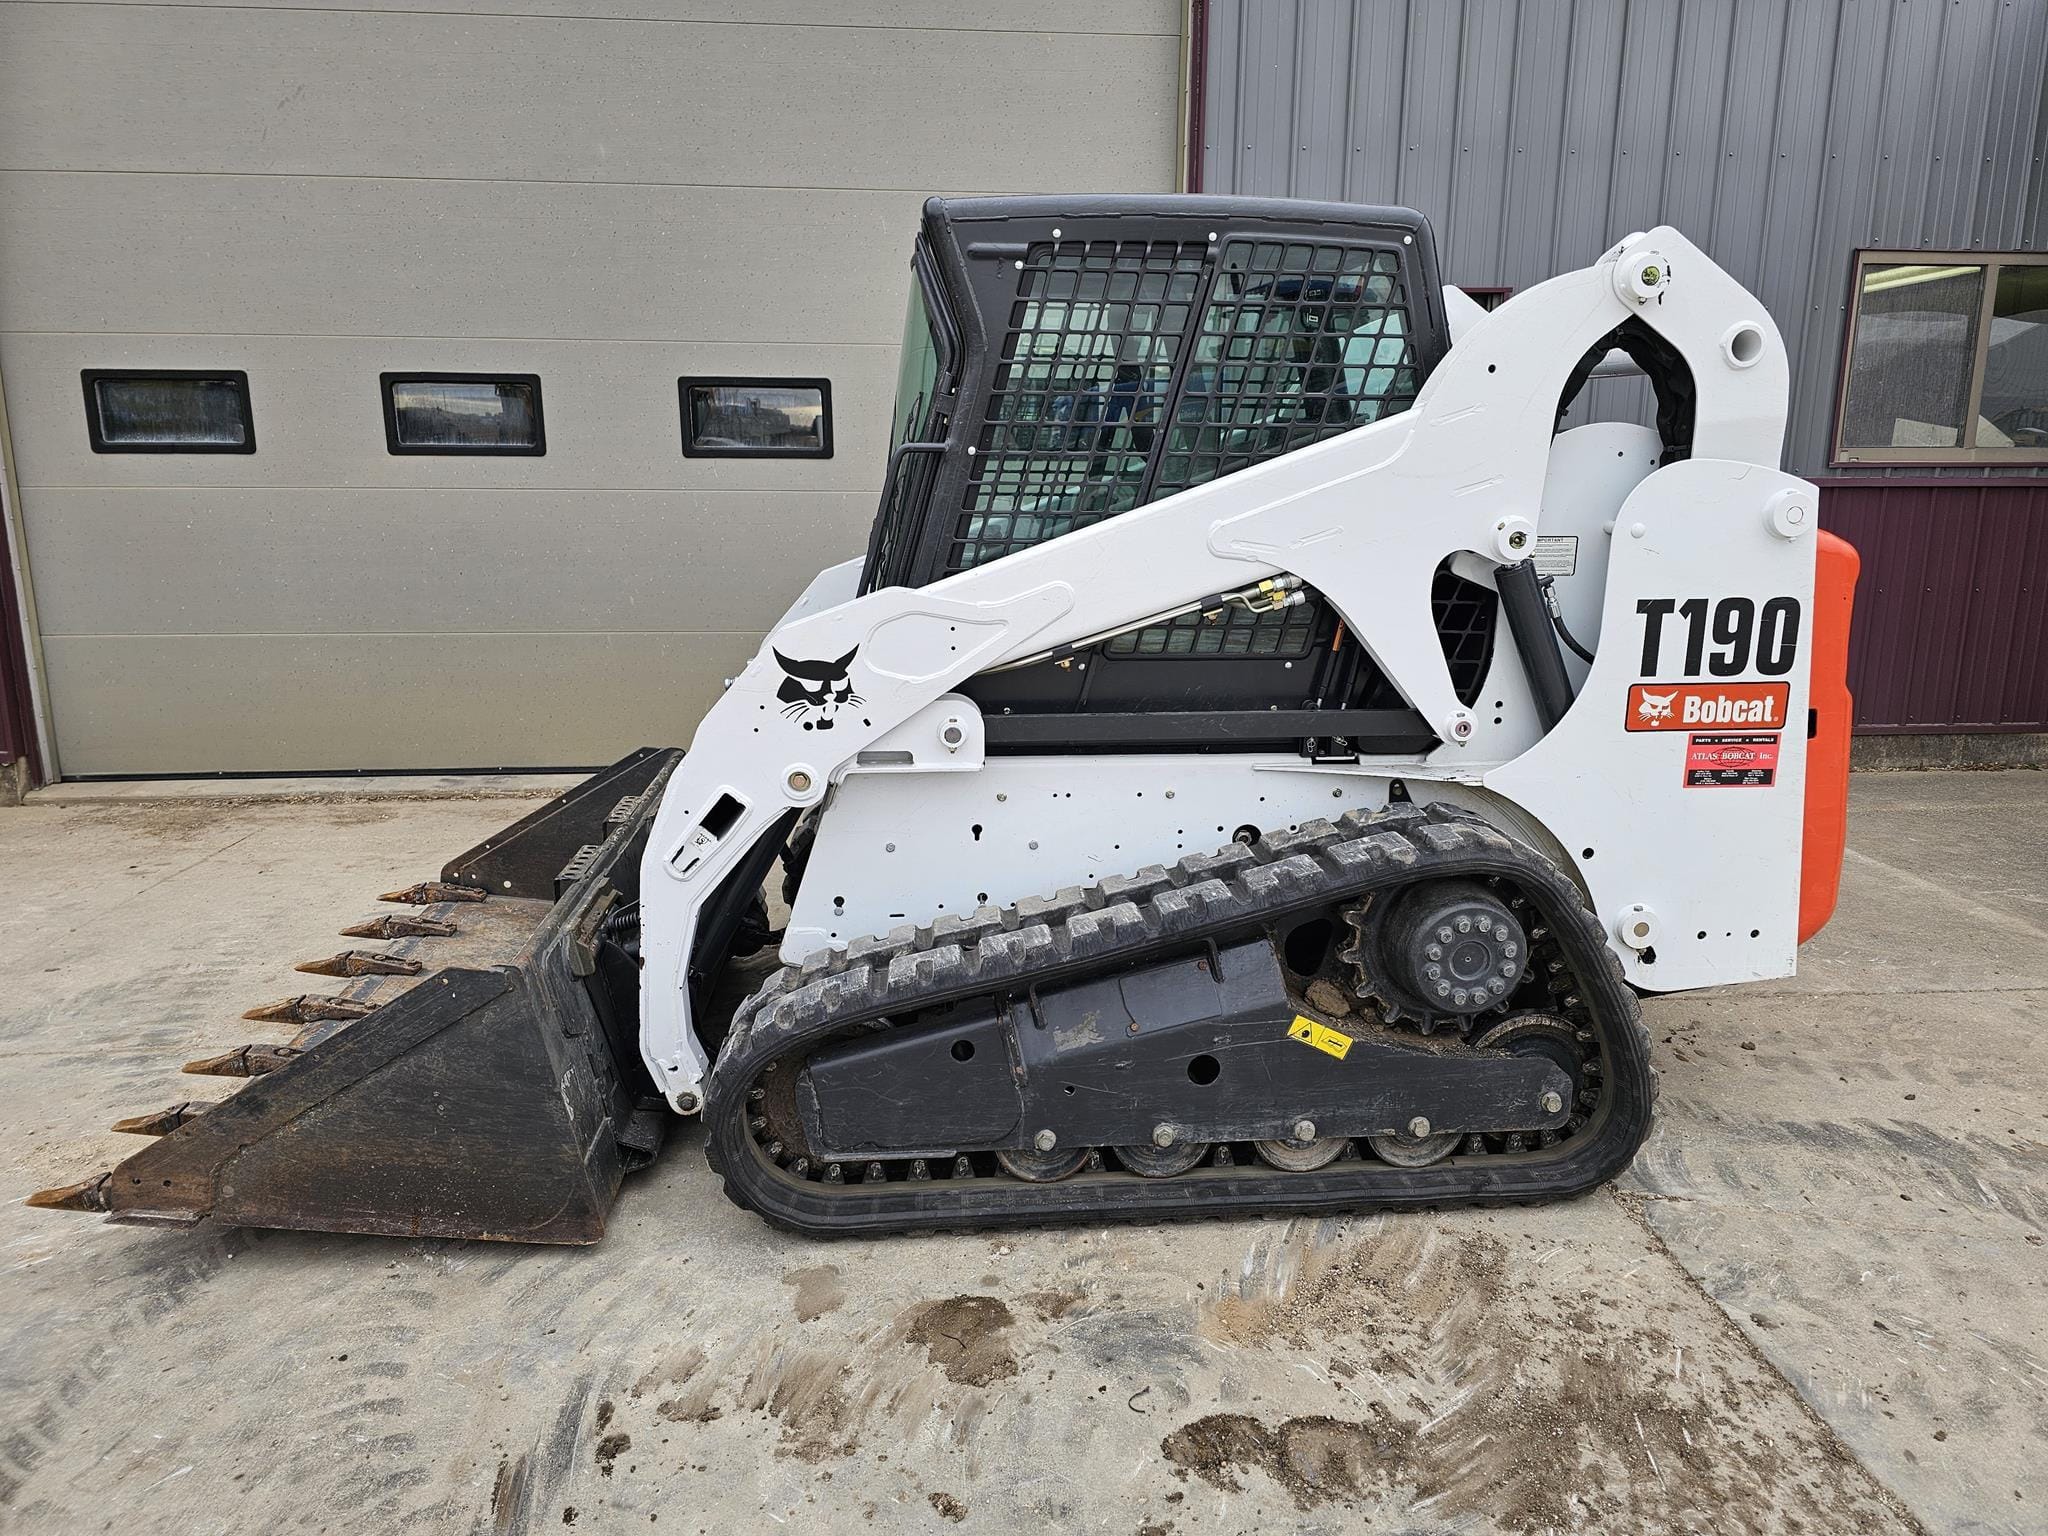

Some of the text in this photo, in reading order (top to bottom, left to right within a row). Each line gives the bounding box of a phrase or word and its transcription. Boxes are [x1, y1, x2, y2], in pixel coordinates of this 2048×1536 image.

[1636, 597, 1801, 677] T190
[1683, 695, 1774, 724] Bobcat
[1691, 752, 1718, 760] ATLAS
[1721, 752, 1756, 760] BOBCAT
